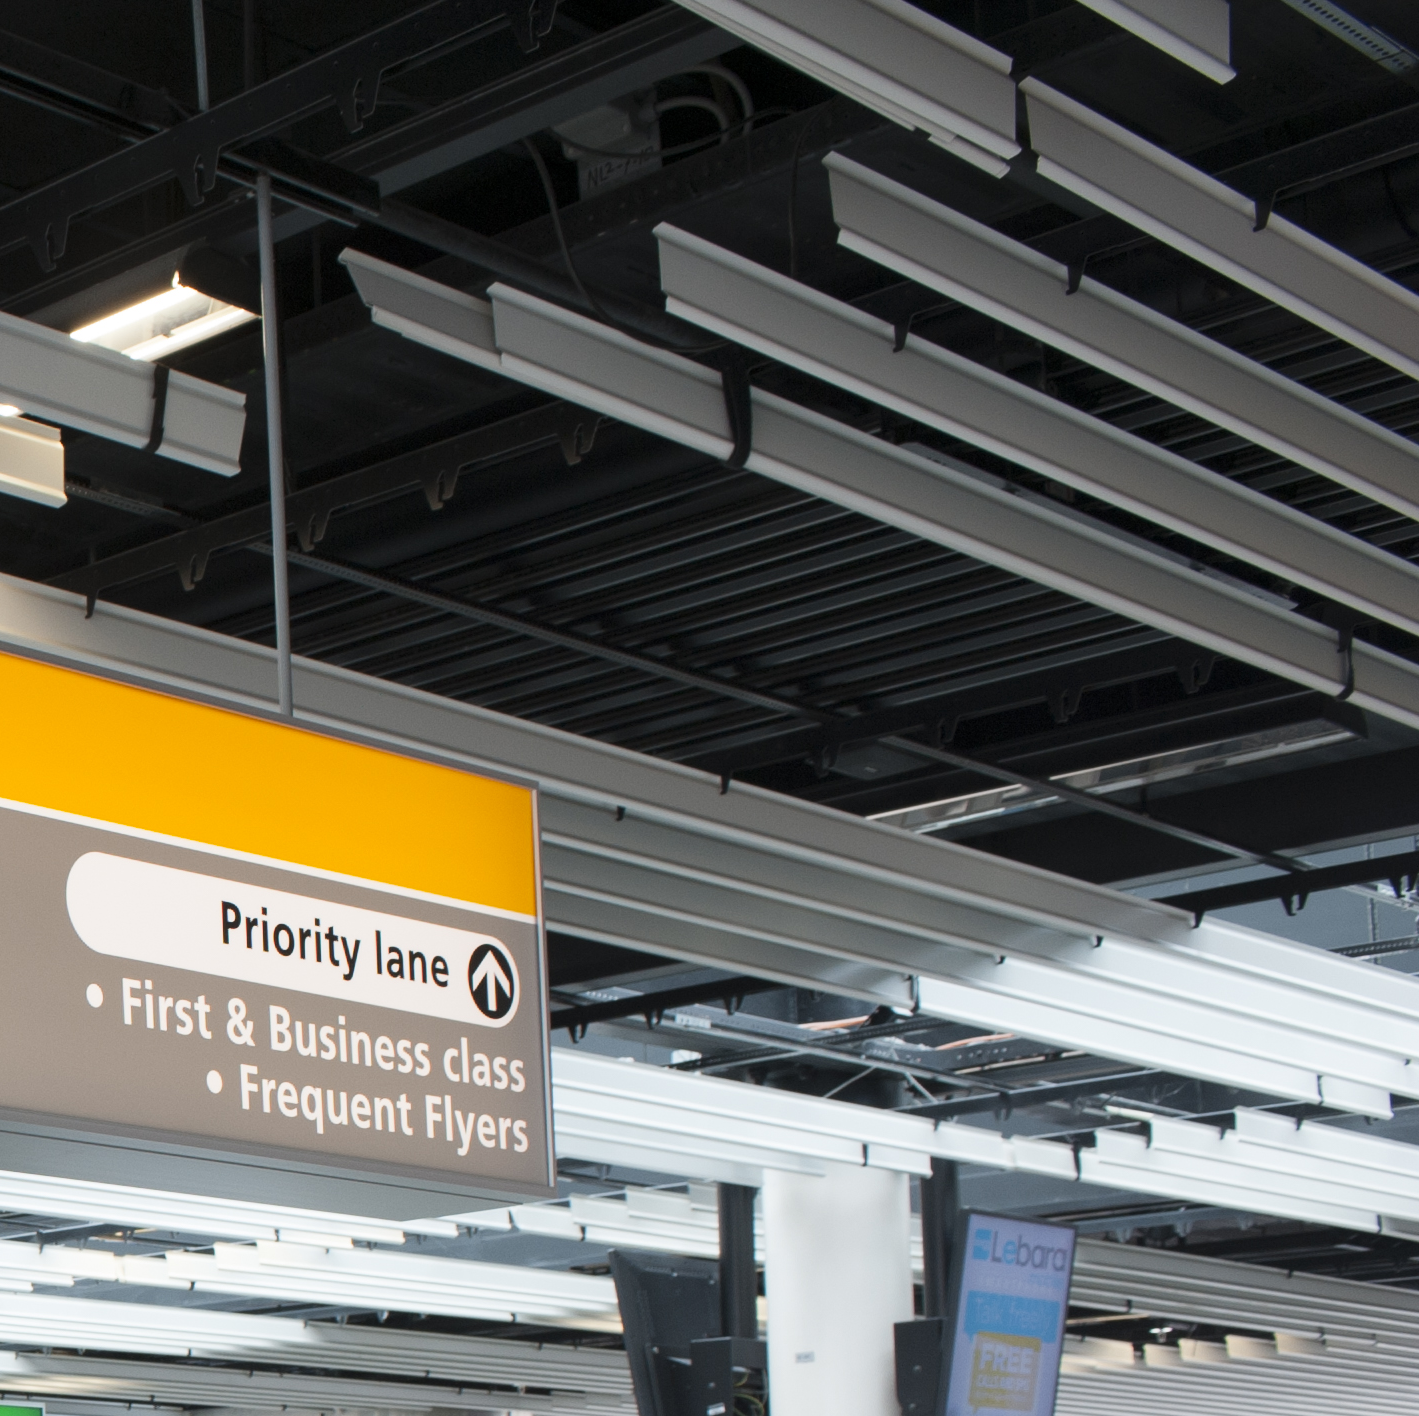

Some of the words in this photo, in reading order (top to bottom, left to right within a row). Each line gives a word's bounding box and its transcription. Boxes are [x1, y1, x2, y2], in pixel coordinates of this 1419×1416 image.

[220, 900, 362, 981] Priority
[373, 930, 450, 989] lane
[120, 978, 213, 1040] First
[225, 997, 257, 1047] &
[269, 1004, 434, 1079] Business
[442, 1033, 527, 1094] class
[239, 1064, 414, 1137] Frequent
[425, 1093, 530, 1158] Flyers
[991, 1231, 1066, 1273] Lebara
[979, 1344, 1035, 1374] FREE
